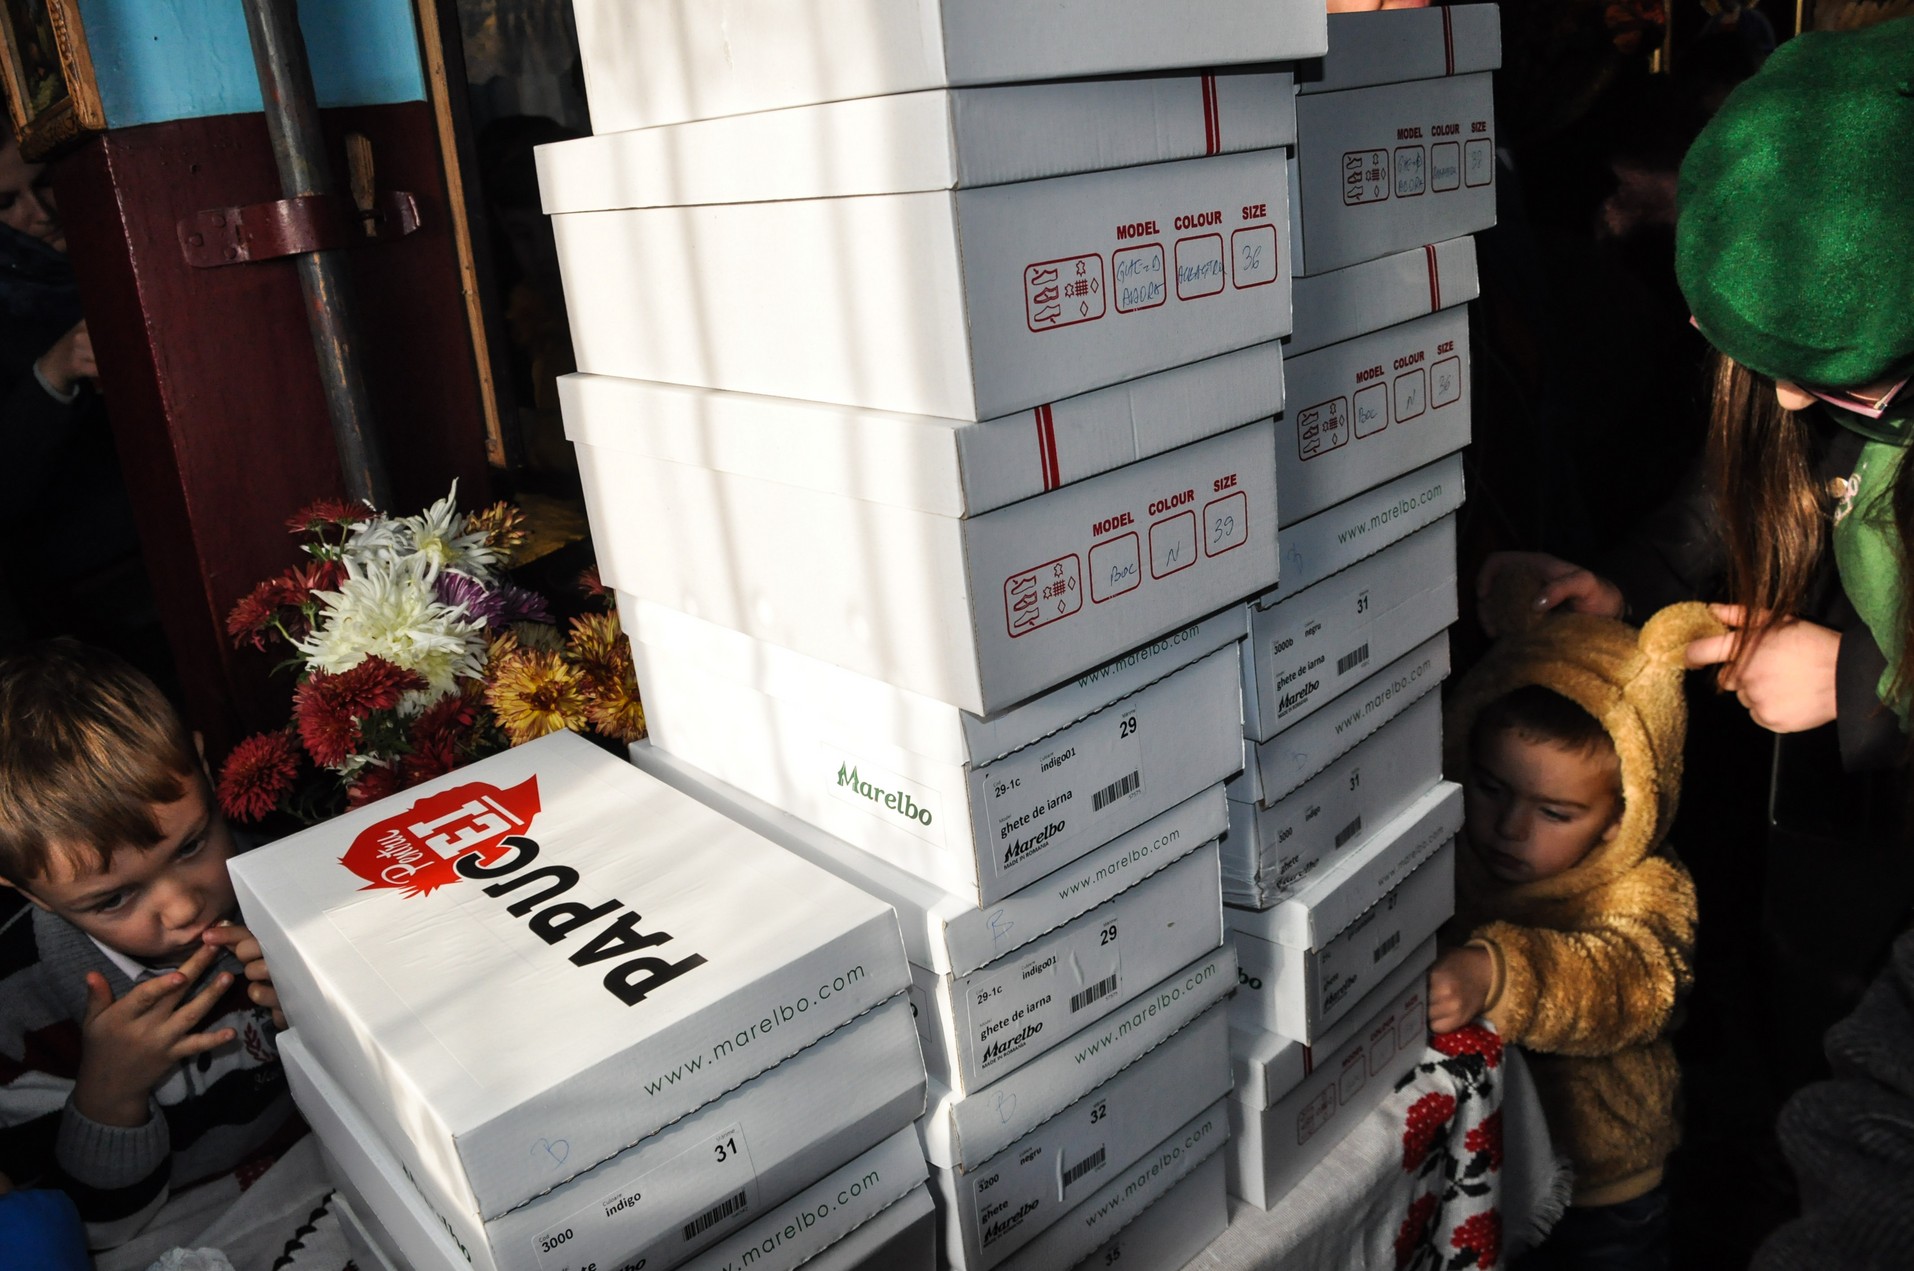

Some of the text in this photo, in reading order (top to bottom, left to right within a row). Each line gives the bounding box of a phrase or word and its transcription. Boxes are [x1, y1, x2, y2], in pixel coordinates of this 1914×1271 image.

[1397, 121, 1486, 140] MODEL COLOUR SIZE
[1116, 204, 1267, 240] MODEL COLOUR SIZE
[1356, 341, 1454, 384] MODEL COLOUR SIZE
[1092, 474, 1237, 537] MODEL COLOUR SIZE
[1337, 484, 1442, 544] www.marelbo.com
[1213, 515, 1234, 544] 39
[1357, 595, 1369, 614] 31
[1304, 623, 1322, 638] negru
[1077, 624, 1200, 688] www.marelbo.com
[1276, 673, 1297, 692] ghete
[1297, 666, 1307, 677] de
[1308, 654, 1325, 671] iarna
[1278, 679, 1320, 713] Marelbo
[1334, 659, 1431, 735] www.marelbo.com
[1119, 716, 1137, 739] 29
[1040, 747, 1077, 773] indigo01
[837, 760, 933, 826] Marelbo
[994, 777, 1021, 798] 29-1c
[1350, 773, 1360, 791] 31
[1000, 790, 1073, 840] ghete de iarna
[1003, 820, 1066, 863] Marelbo
[1003, 841, 1050, 871] MADE IN ROMANIA
[376, 829, 435, 885] Pentru
[1058, 828, 1181, 900] www.marelbo.com
[1100, 925, 1117, 947] 29
[1022, 955, 1057, 980] indigo01
[977, 985, 1003, 1005] 29-1c
[980, 994, 1051, 1042] ghete de iarna
[1074, 962, 1216, 1066] www.marelbo.com
[643, 963, 866, 1097] www.marelbo.com
[982, 1021, 1044, 1063] Marelbo
[982, 1058, 997, 1070] MADE
[1003, 1041, 1027, 1057] ROMANIA
[1090, 1105, 1107, 1125] 32
[714, 1136, 739, 1163] 31
[1020, 1147, 1042, 1166] negru
[978, 1173, 999, 1193] 3200
[1085, 1119, 1213, 1227] www.marelbo.com
[604, 1191, 642, 1218] indigo
[982, 1200, 1009, 1225] ghete
[984, 1199, 1039, 1243] Marelbo
[538, 1233, 550, 1244] Cod
[541, 1228, 574, 1253] 3000
